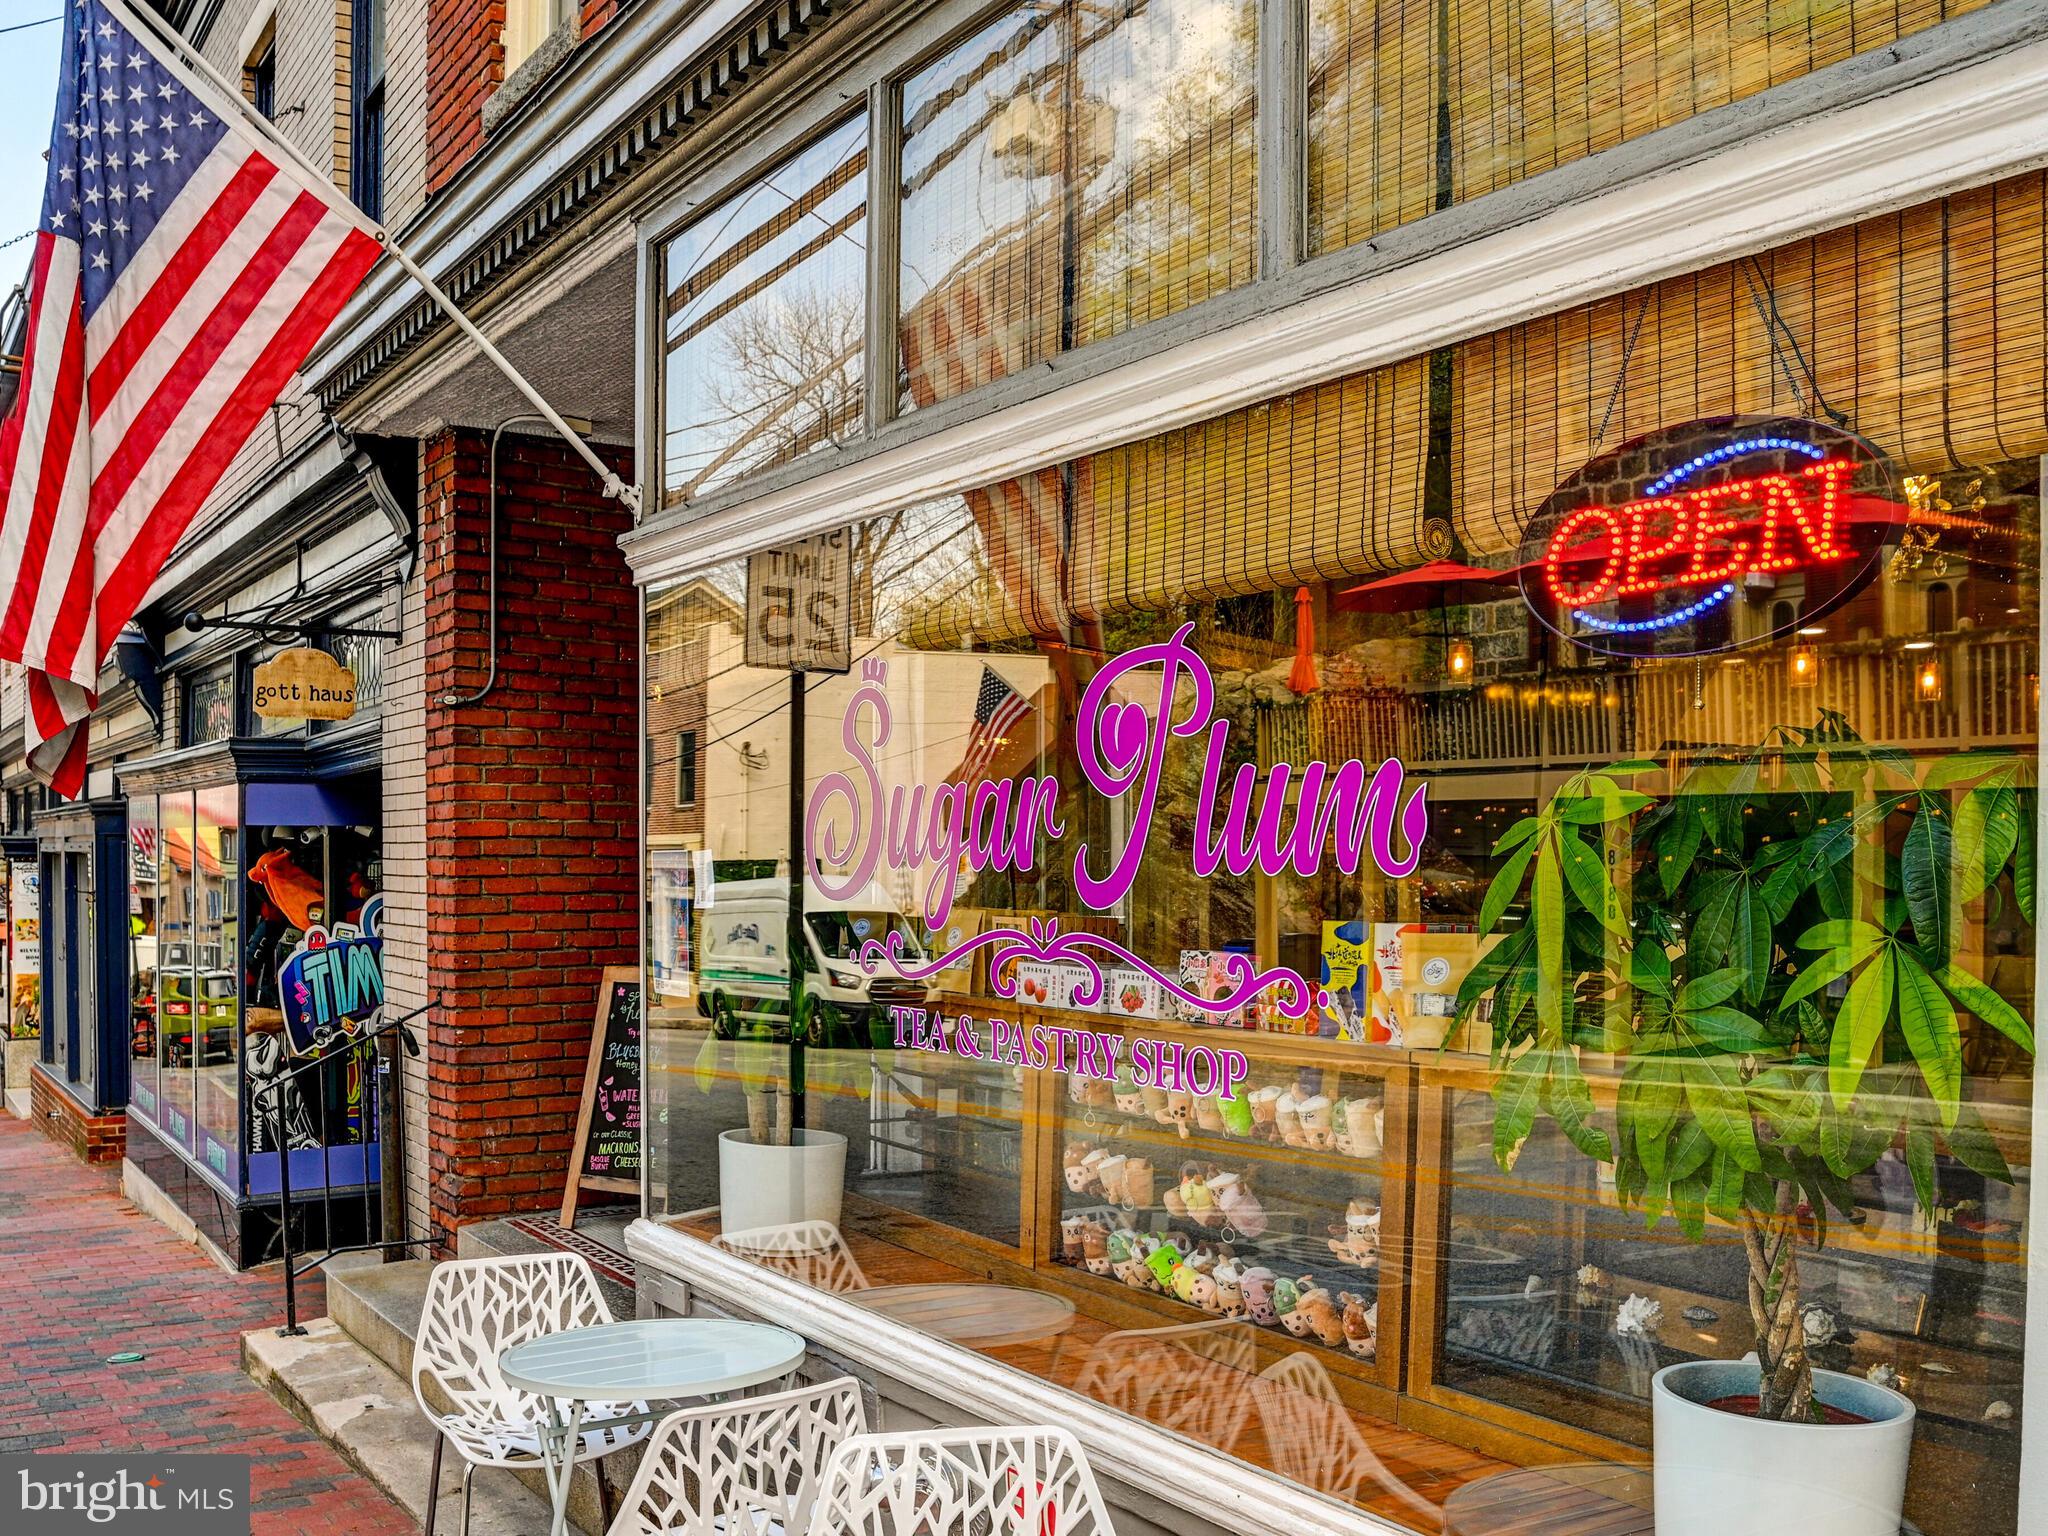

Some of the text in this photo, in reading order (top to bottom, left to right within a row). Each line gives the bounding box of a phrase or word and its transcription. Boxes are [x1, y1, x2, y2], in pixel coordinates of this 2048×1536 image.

[1545, 457, 1851, 606] OPEN
[255, 684, 353, 707] gott haus
[804, 622, 1429, 928] Sugar Plum
[303, 944, 384, 1025] TIM
[890, 1005, 1248, 1102] TEA & PASTRY SHOP
[616, 1060, 640, 1075] Honey
[610, 1130, 632, 1139] CLASSIC
[599, 1142, 639, 1155] MACARONS
[590, 1155, 610, 1163] BASQUE
[590, 1162, 609, 1171] BURNT
